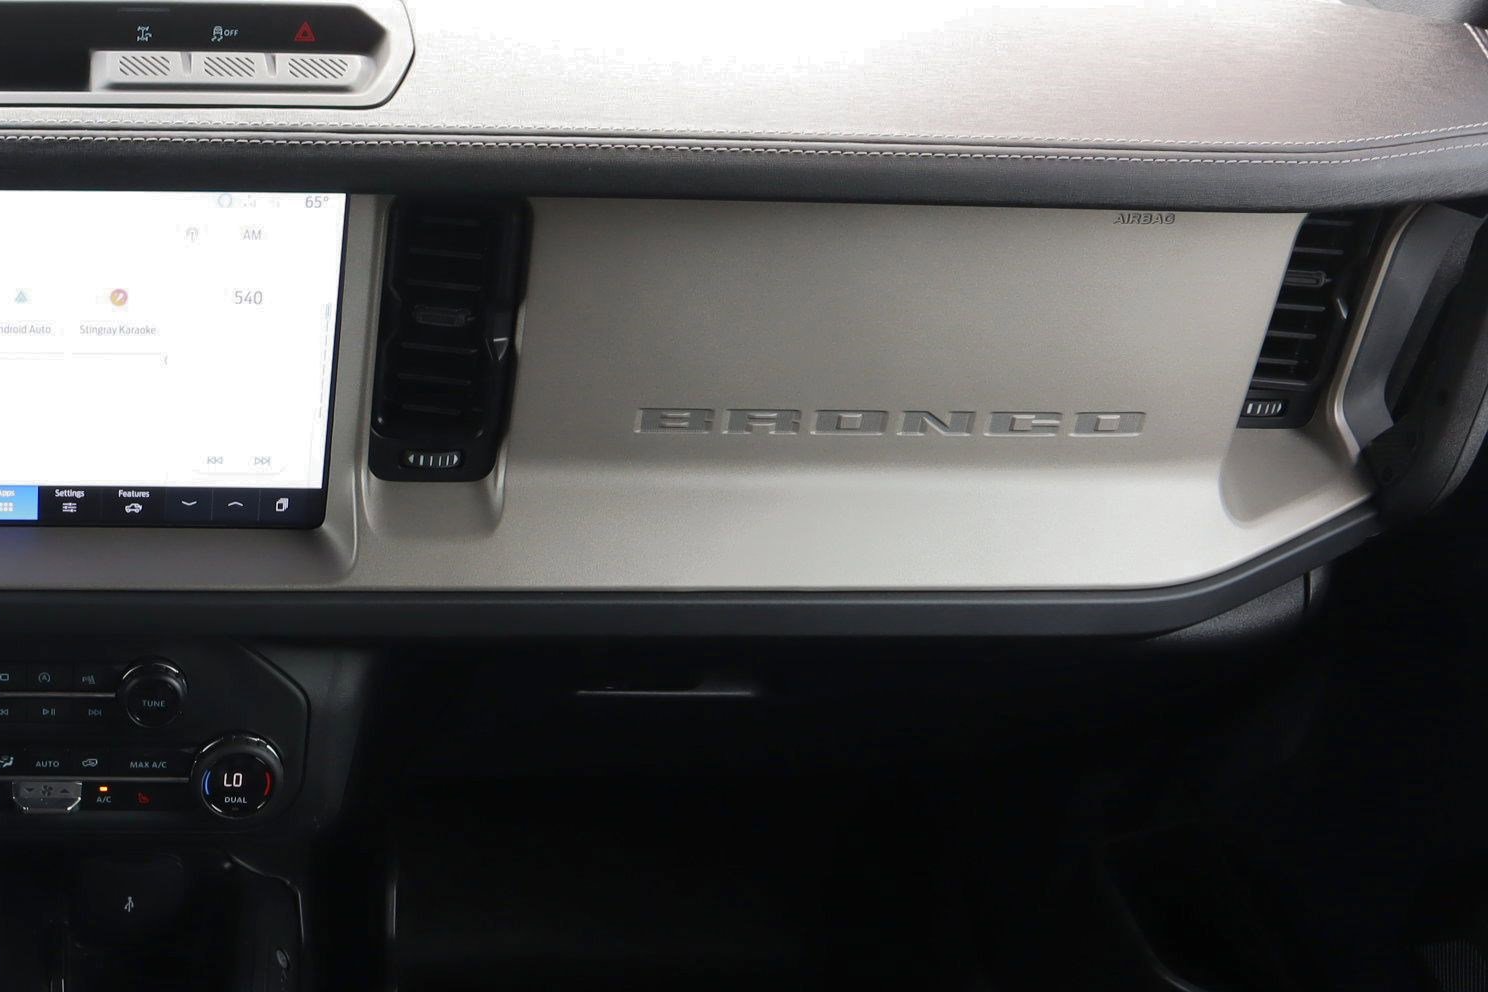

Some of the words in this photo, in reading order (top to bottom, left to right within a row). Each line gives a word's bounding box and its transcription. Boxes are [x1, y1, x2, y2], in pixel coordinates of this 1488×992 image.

[223, 29, 239, 37] OFF
[305, 196, 329, 208] 65°
[1113, 212, 1176, 225] AIRBAG
[243, 229, 261, 240] AM
[234, 290, 262, 305] 540
[29, 324, 51, 334] Auto
[80, 324, 117, 336] Stingray
[119, 324, 156, 334] Karaoke
[634, 407, 1146, 437] BRONCO
[55, 489, 85, 499] Settings
[118, 490, 150, 498] Features
[35, 760, 60, 768] AUTO
[130, 761, 150, 769] MAX
[151, 761, 167, 769] A/C
[223, 772, 243, 788] LO
